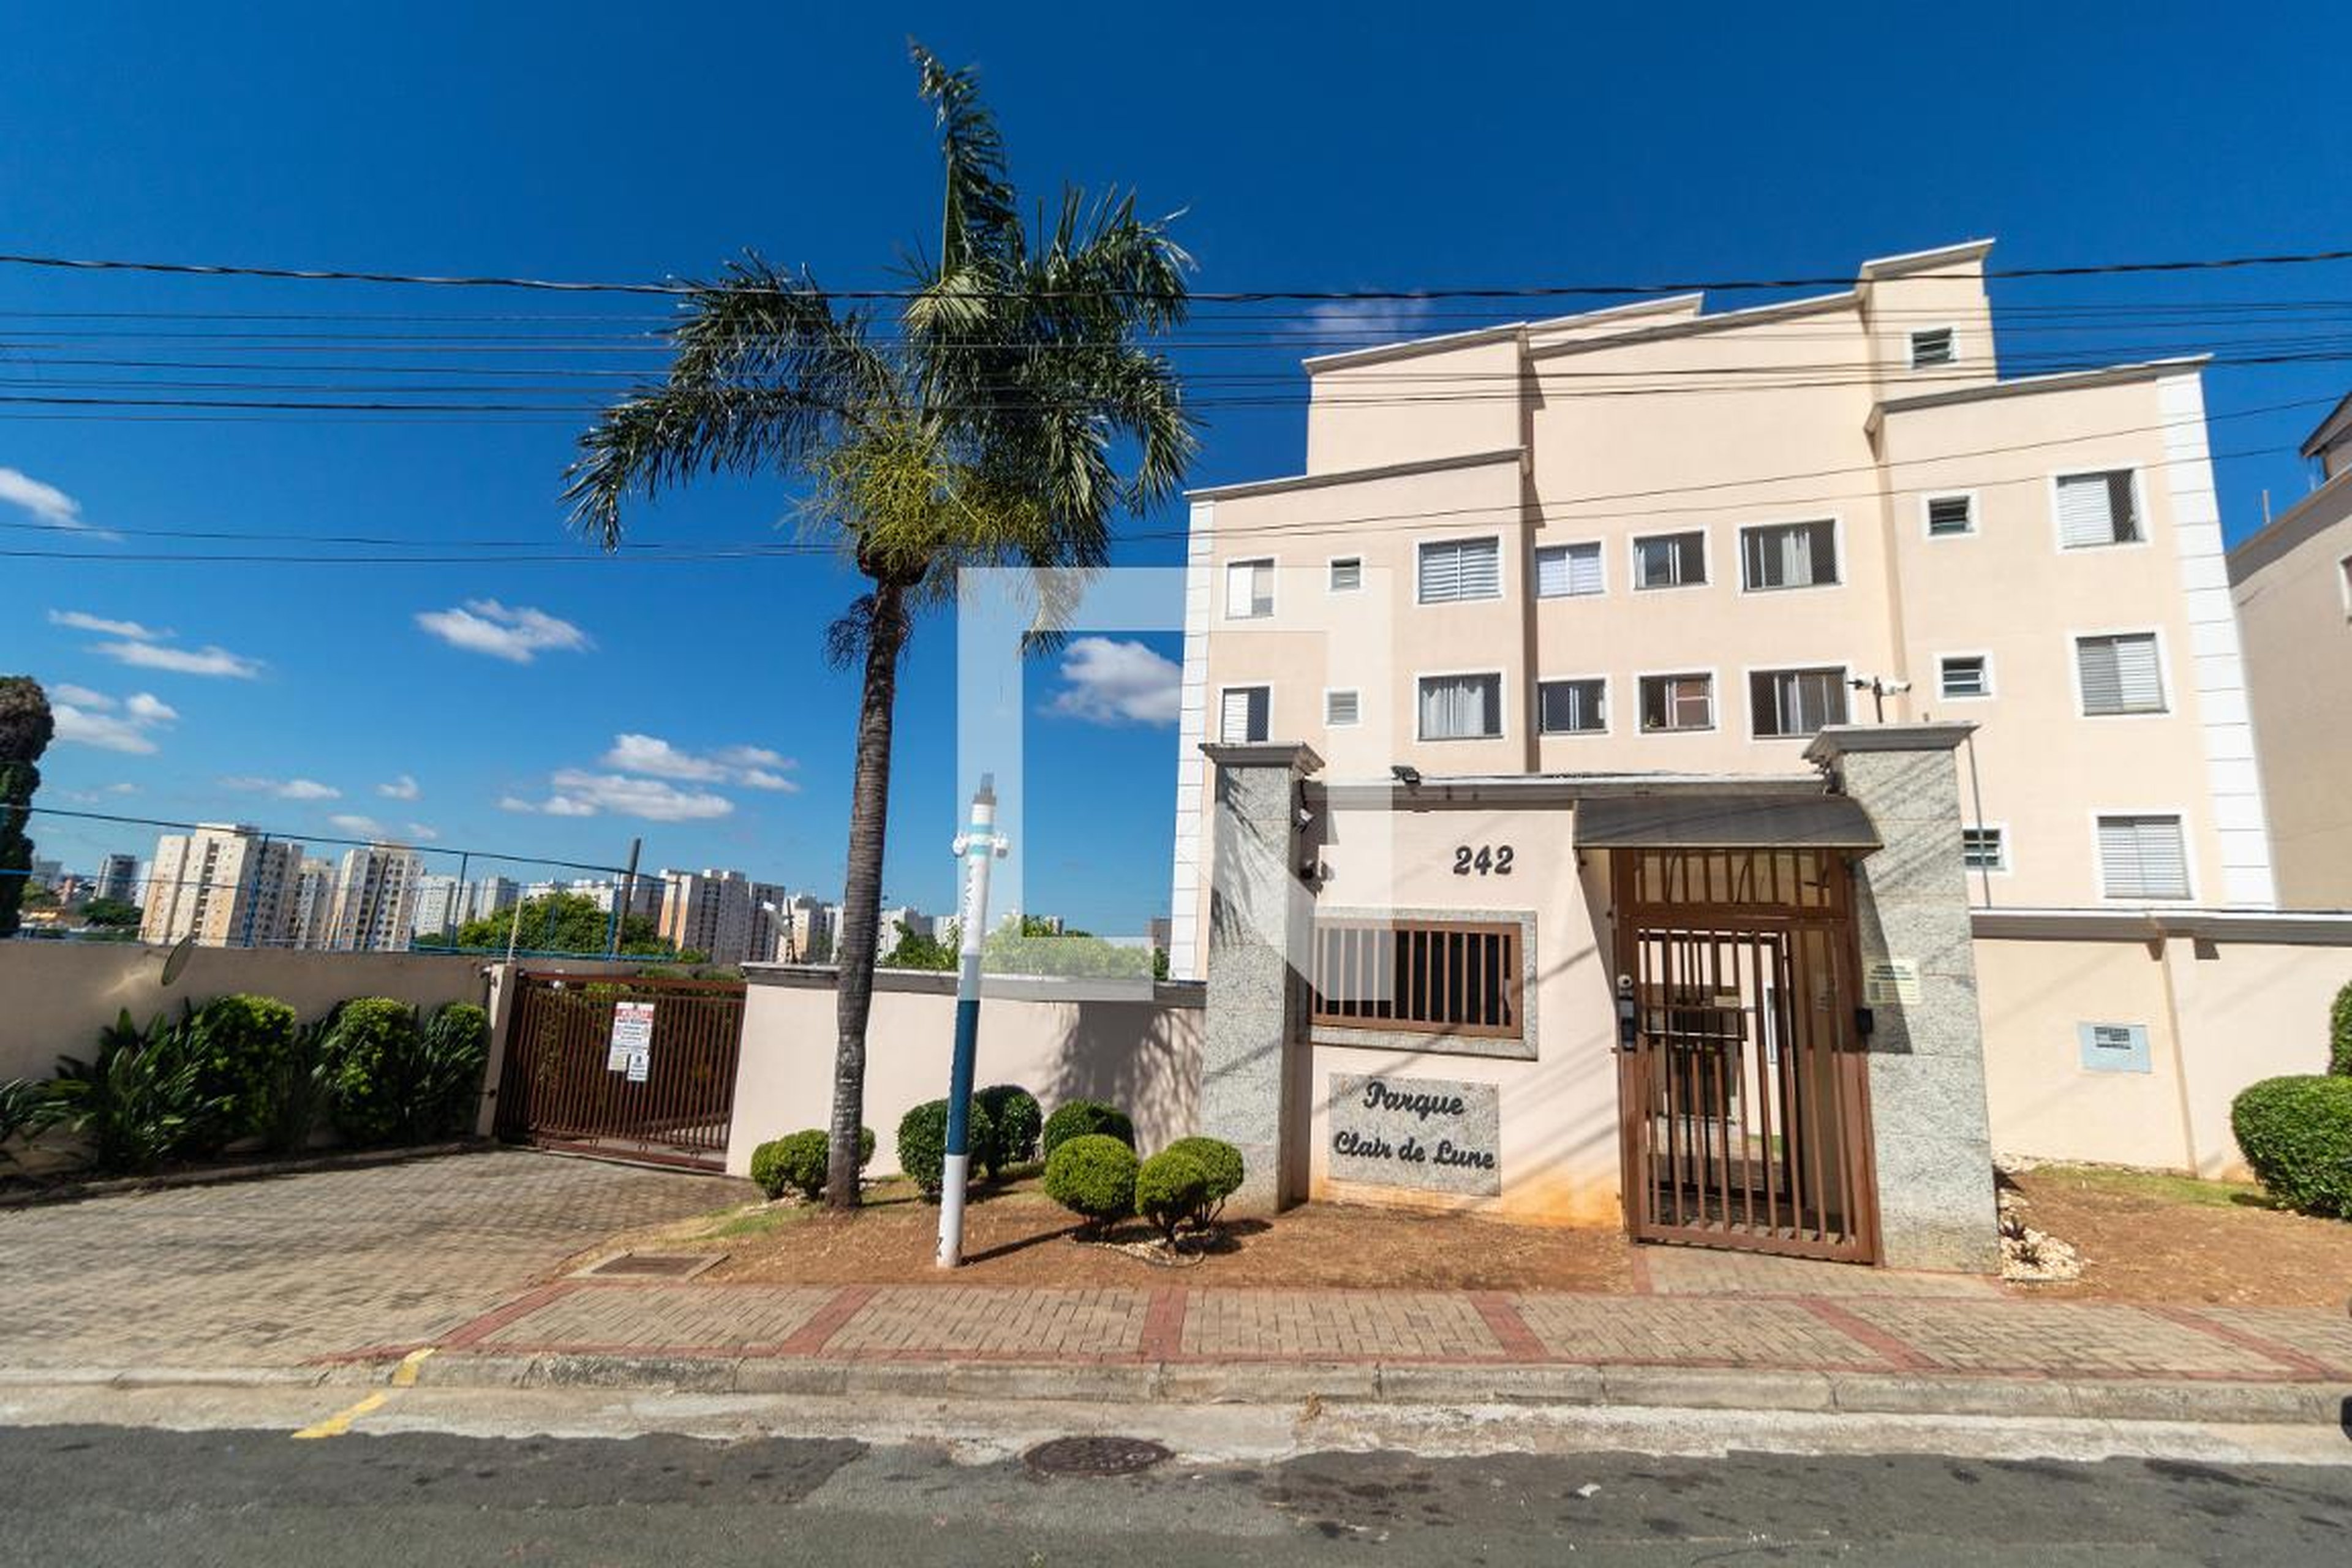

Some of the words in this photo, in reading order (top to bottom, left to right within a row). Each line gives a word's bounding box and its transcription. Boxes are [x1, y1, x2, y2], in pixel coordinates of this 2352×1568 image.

[1453, 845, 1513, 875] 242
[1363, 1081, 1464, 1121] Parque
[1334, 1131, 1392, 1159] Clair
[1398, 1137, 1425, 1163] de
[1433, 1140, 1494, 1170] Lune
